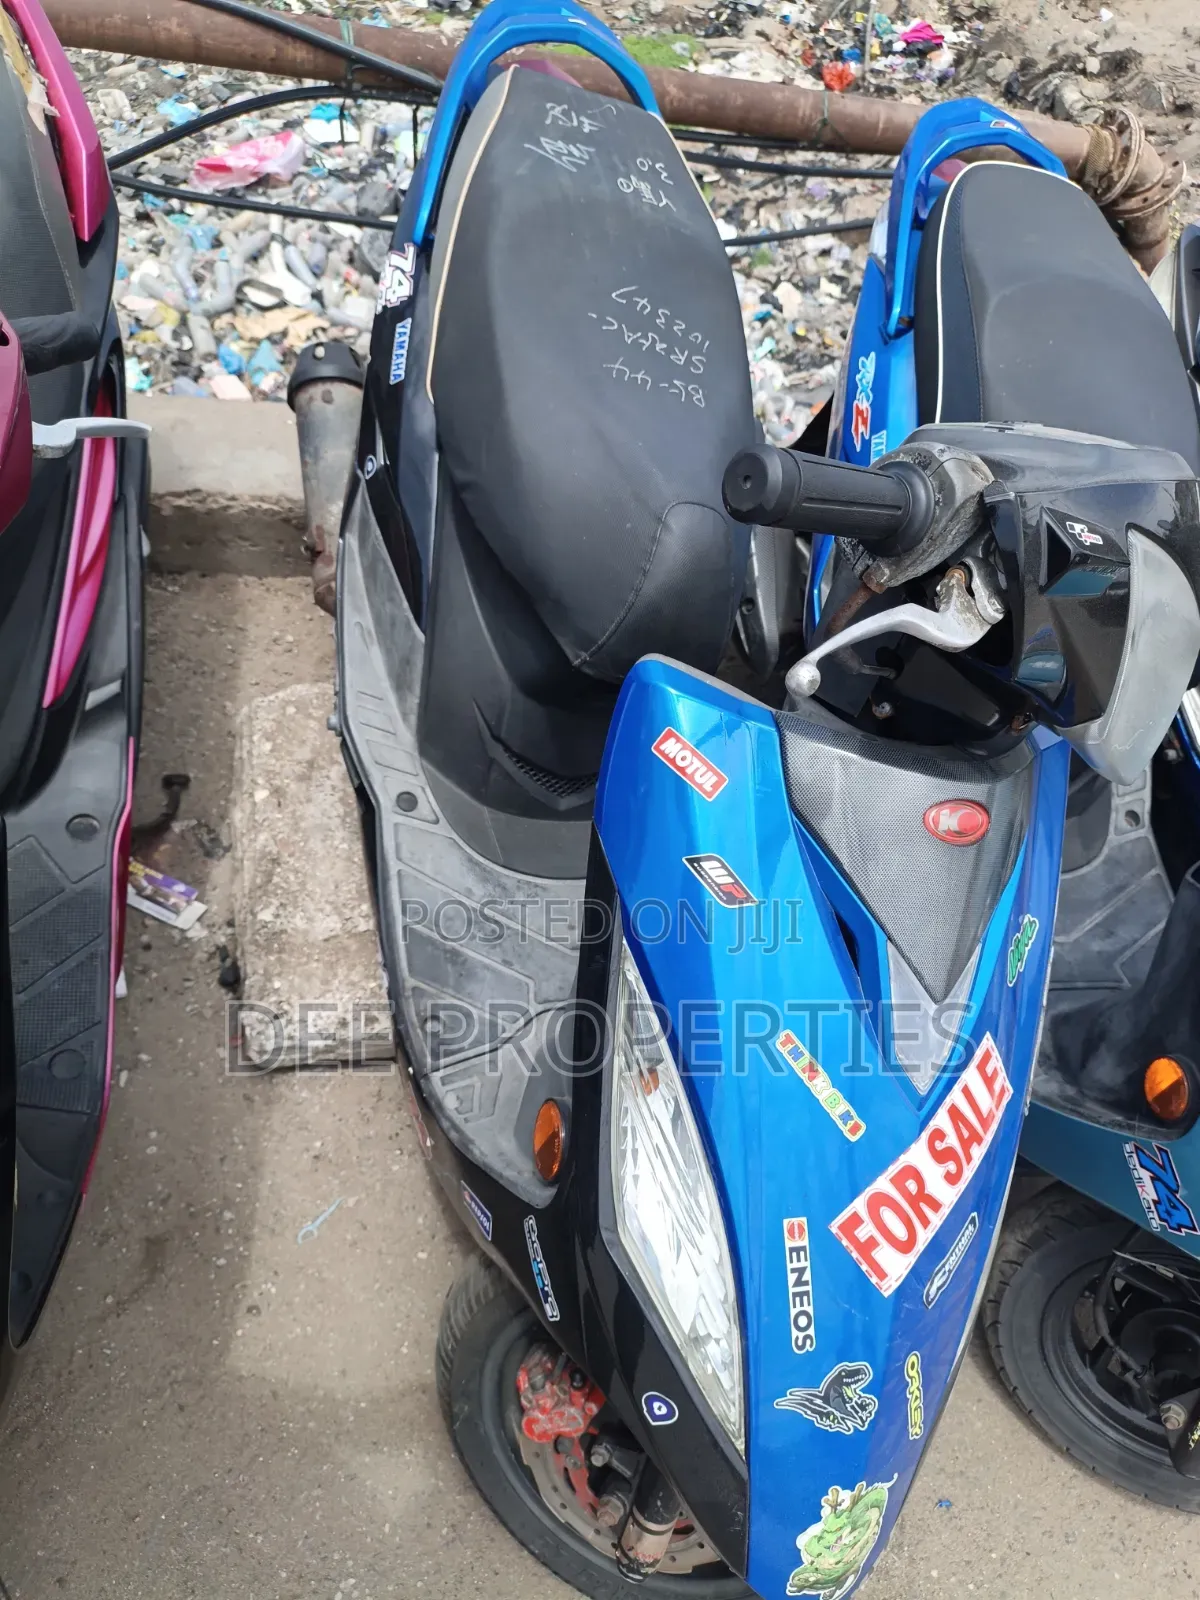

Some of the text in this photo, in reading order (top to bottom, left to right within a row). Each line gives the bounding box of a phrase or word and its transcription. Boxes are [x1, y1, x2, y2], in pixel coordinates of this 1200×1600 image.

[388, 243, 416, 305] 74
[391, 321, 408, 383] YAMAHA
[659, 737, 719, 793] MOTUL
[780, 1033, 829, 1094] THINK
[837, 1046, 1007, 1283] FOR SALE
[1132, 1143, 1200, 1234] 74
[788, 1244, 815, 1352] ENEOS
[907, 1354, 921, 1436] OAKLEY
